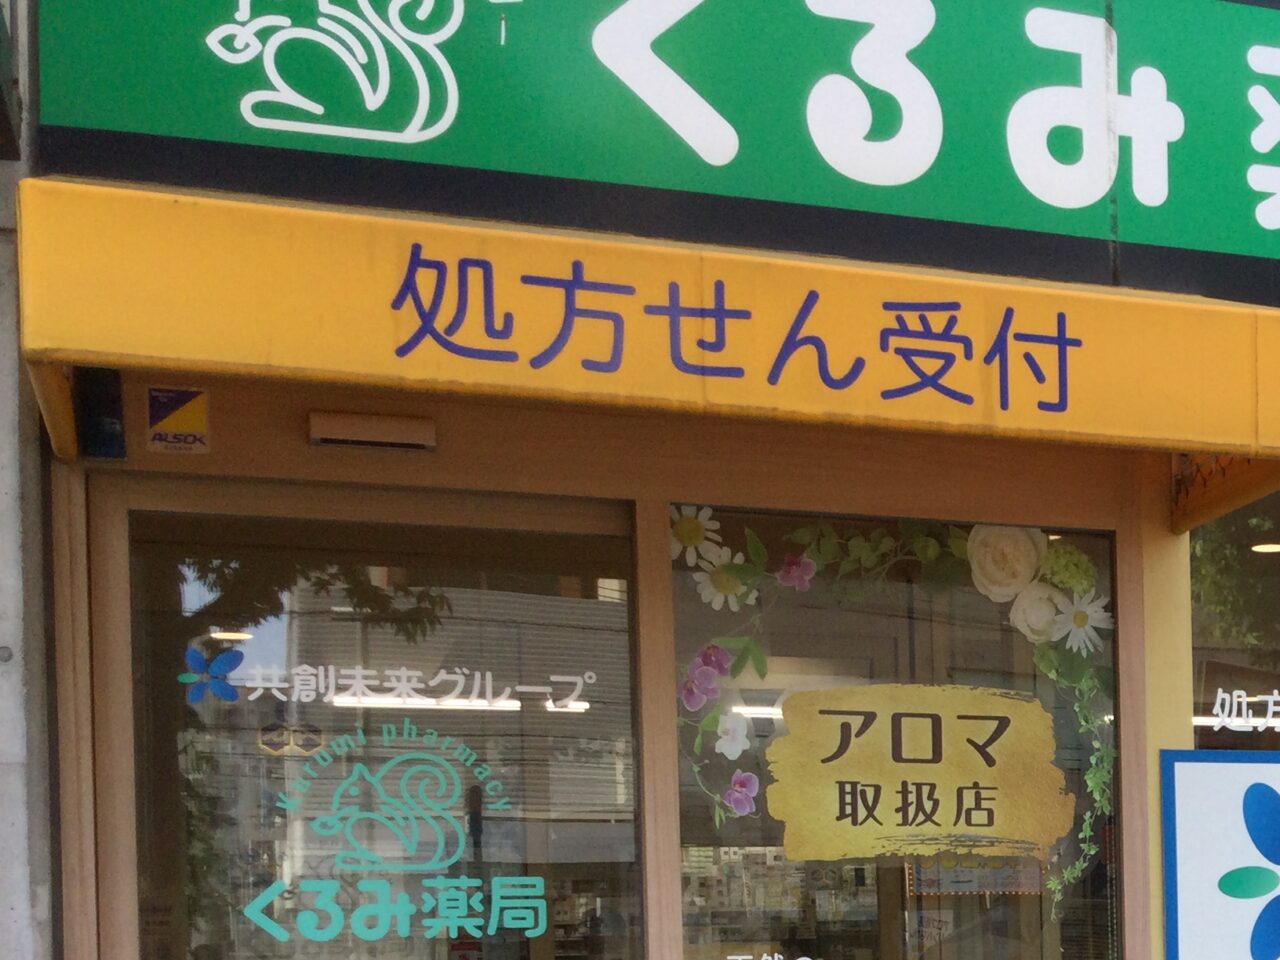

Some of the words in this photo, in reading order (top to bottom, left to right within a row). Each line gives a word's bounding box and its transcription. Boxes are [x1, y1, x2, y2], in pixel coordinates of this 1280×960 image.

[390, 242, 1083, 414] 処方せん受付
[150, 432, 208, 447] ALSOK
[244, 663, 598, 708] 共創未来グループ
[818, 708, 1012, 768] アロマ
[834, 779, 999, 829] 取扱店
[242, 874, 548, 943] くるみ薬局
